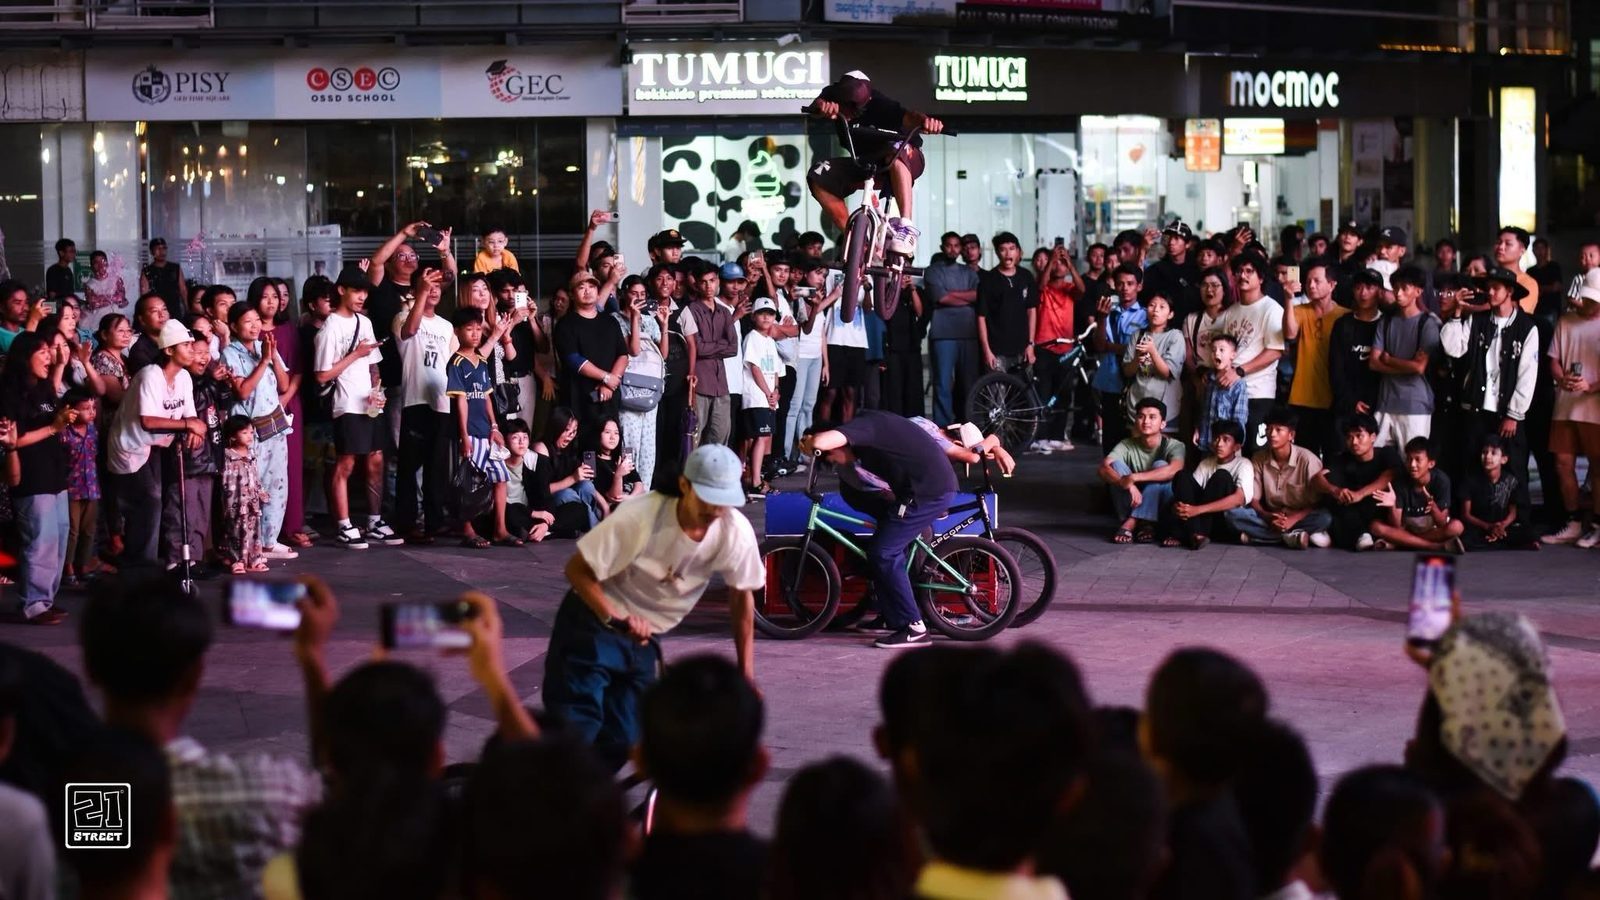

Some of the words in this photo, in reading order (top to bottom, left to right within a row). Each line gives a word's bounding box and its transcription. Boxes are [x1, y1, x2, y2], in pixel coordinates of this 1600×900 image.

[308, 69, 398, 89] CSEC
[632, 51, 824, 87] TUMUGI
[935, 55, 1027, 89] TUMUGI
[176, 71, 231, 93] PISY
[505, 74, 564, 96] GEC
[1230, 70, 1339, 108] mocmoc
[311, 94, 342, 102] OSSD
[347, 93, 397, 102] SCHOOL
